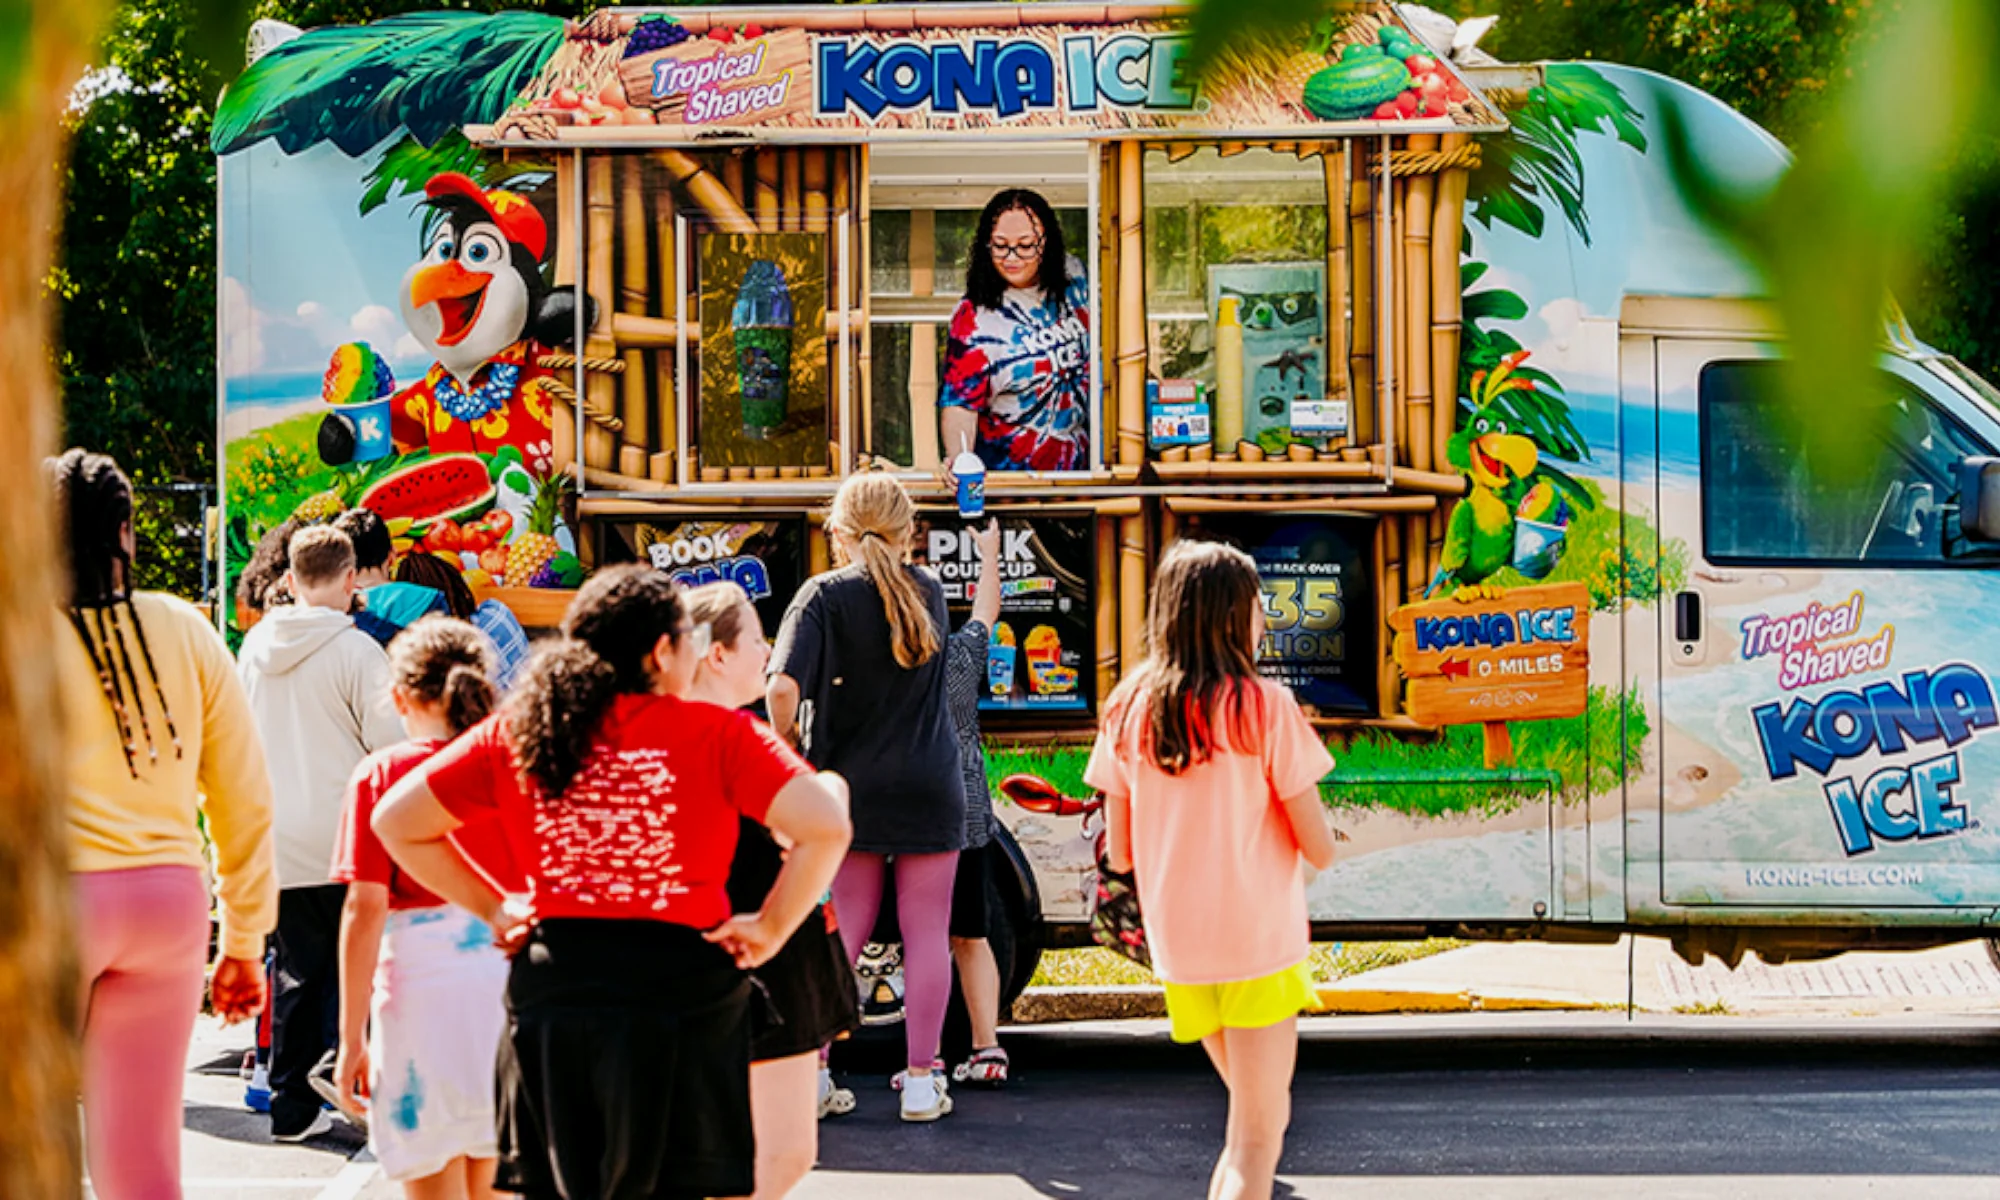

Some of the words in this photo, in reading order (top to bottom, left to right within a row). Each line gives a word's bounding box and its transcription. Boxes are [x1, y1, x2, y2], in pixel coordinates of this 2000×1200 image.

[654, 42, 766, 95] Tropical
[817, 38, 1055, 119] KONA
[1063, 35, 1200, 112] ICE
[686, 72, 789, 122] Shaved
[1021, 316, 1086, 355] KONA
[1048, 341, 1081, 373] ICE
[359, 416, 383, 442] K
[648, 530, 734, 569] BOOK
[1307, 563, 1341, 575] OVER
[1415, 612, 1515, 652] KONA
[1517, 606, 1576, 644] ICE
[1741, 591, 1863, 658] Tropical
[1500, 653, 1564, 676] MILES
[1780, 627, 1892, 688] Shaved
[1751, 661, 1999, 780] KONA
[1823, 751, 1968, 857] ICE
[1745, 866, 1923, 888] KONA-ICE.COM
